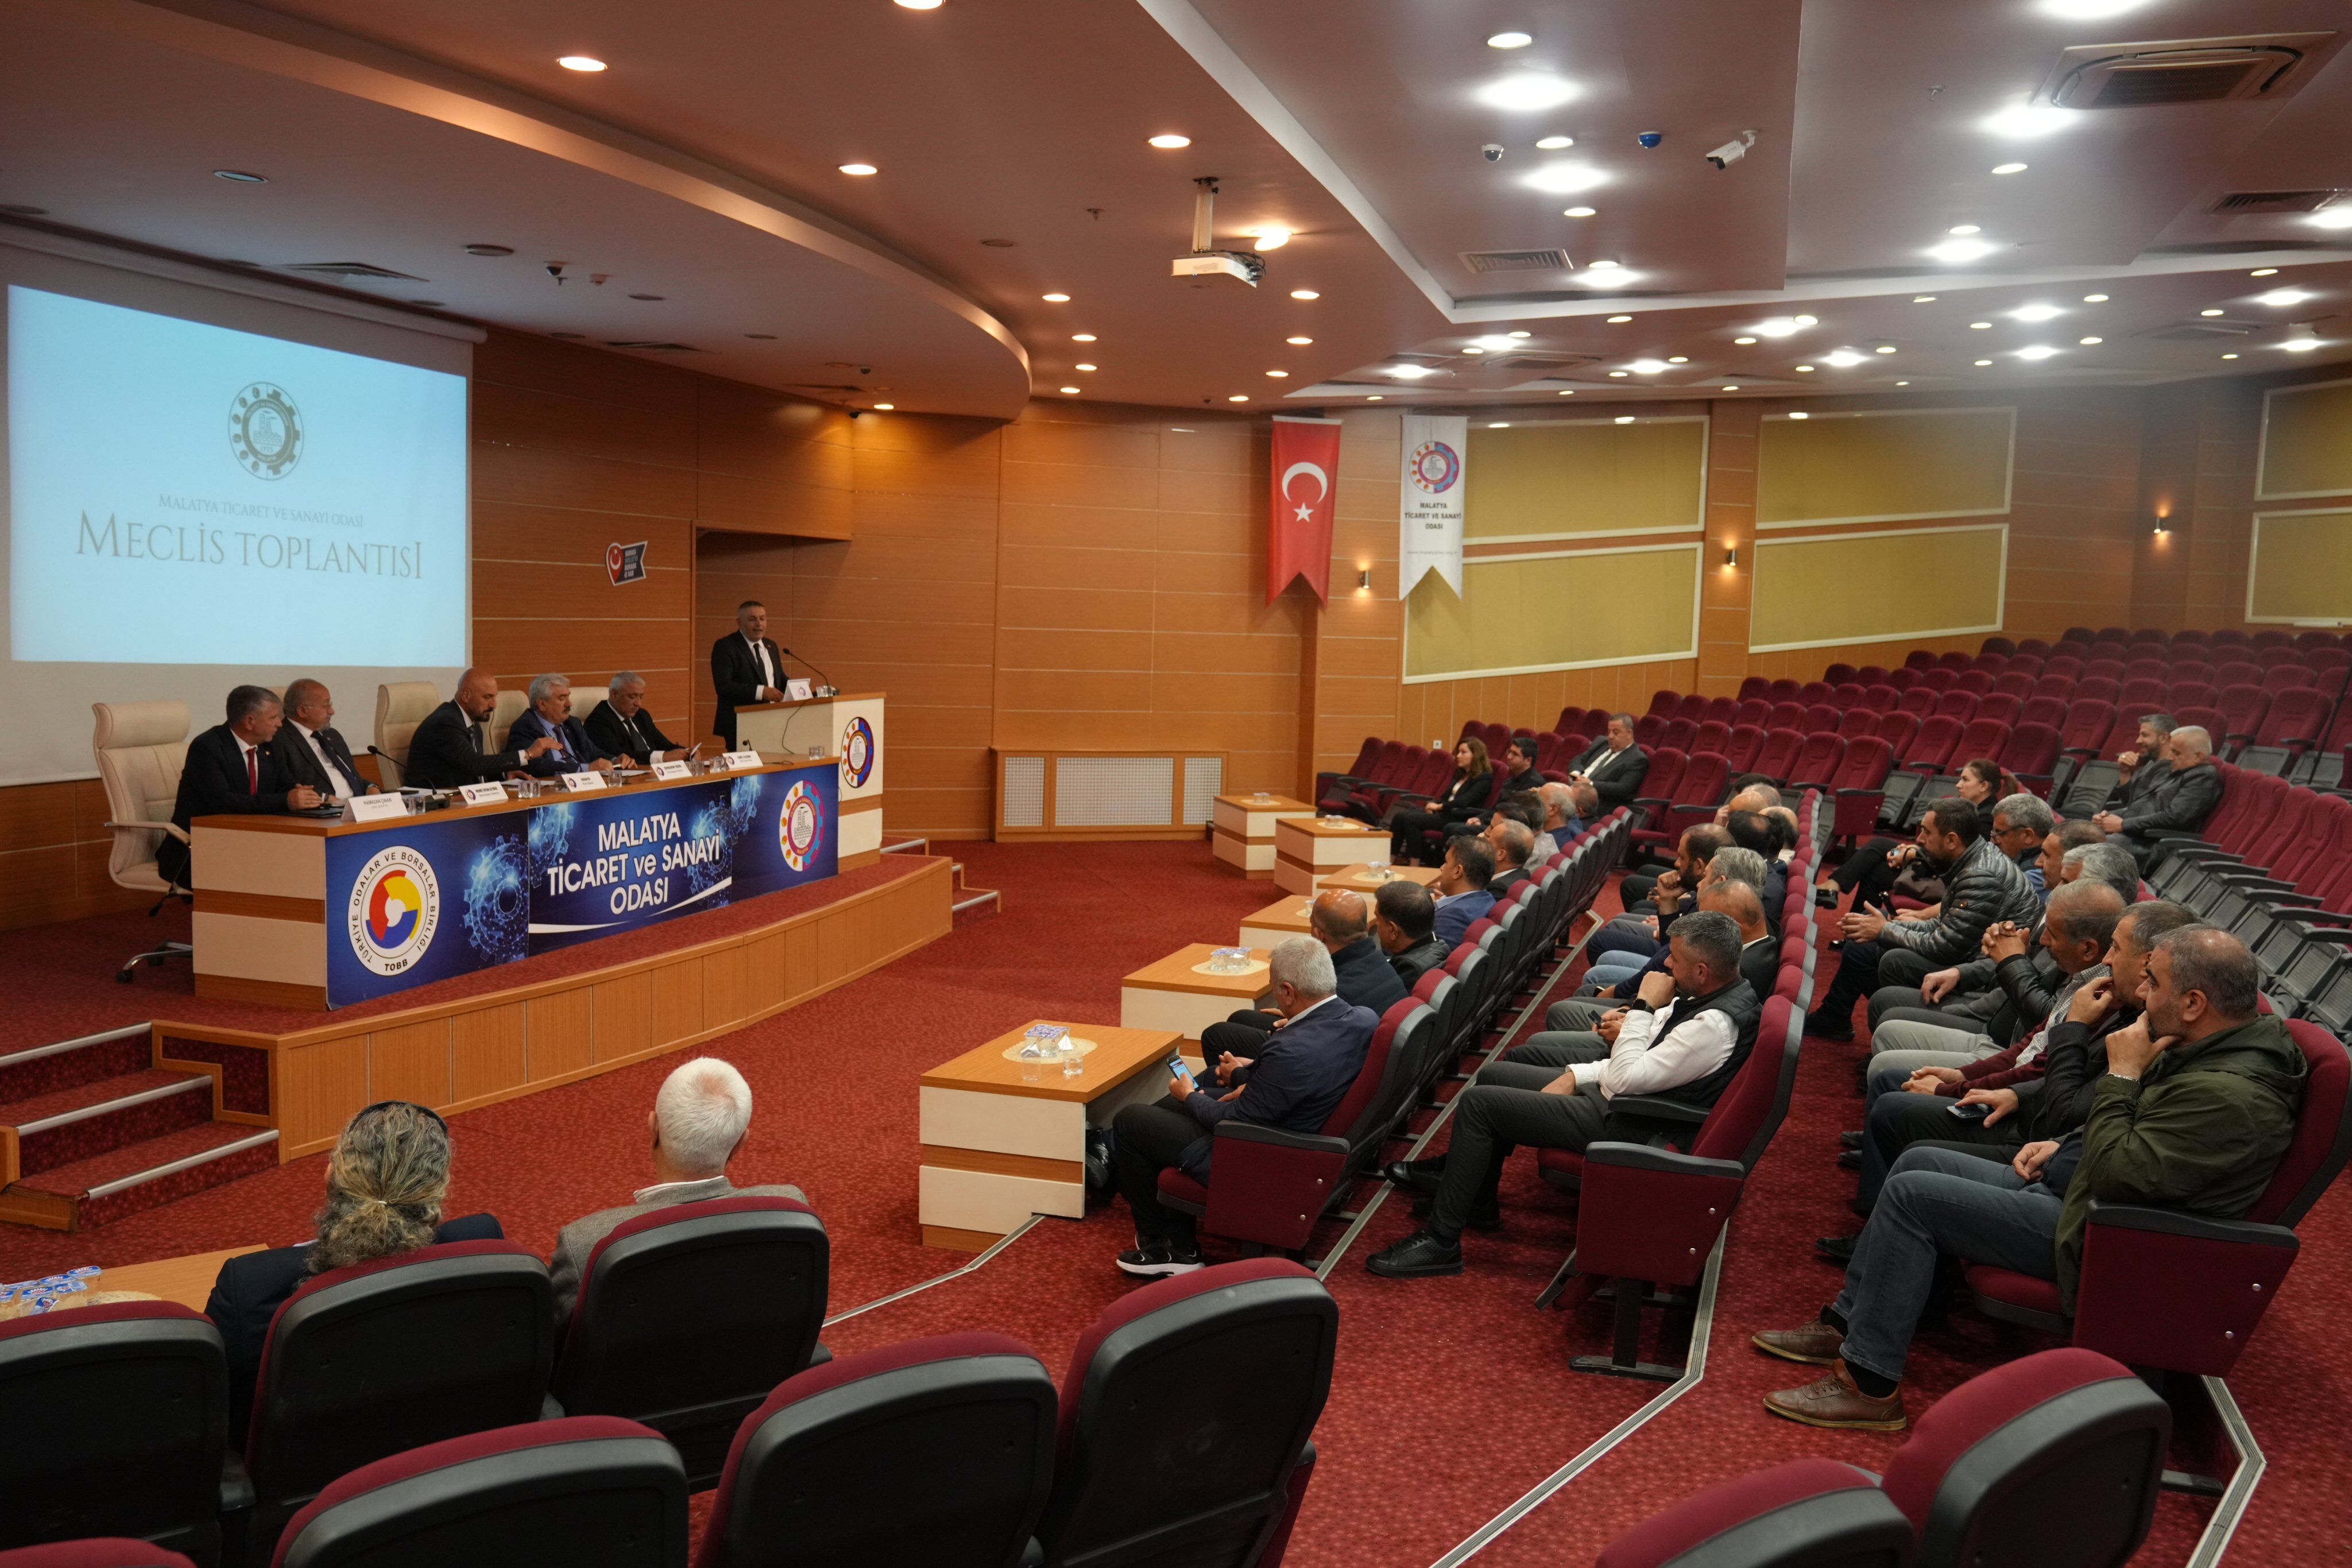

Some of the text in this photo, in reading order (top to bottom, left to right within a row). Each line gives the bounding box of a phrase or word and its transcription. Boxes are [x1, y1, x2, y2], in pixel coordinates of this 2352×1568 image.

[158, 493, 218, 513] MALATYA
[272, 507, 287, 520] VE
[76, 509, 423, 579] MECLİS TOPLANTISI
[598, 812, 681, 852] MALATYA
[385, 852, 396, 861] VE
[401, 852, 435, 899] BORSALAR
[547, 828, 720, 896] TİCARET ve SANAYİ
[354, 860, 380, 906] ODALAR
[610, 877, 668, 915] ODASI
[352, 915, 373, 963] TÜRKİYE
[385, 959, 408, 971] TOBB
